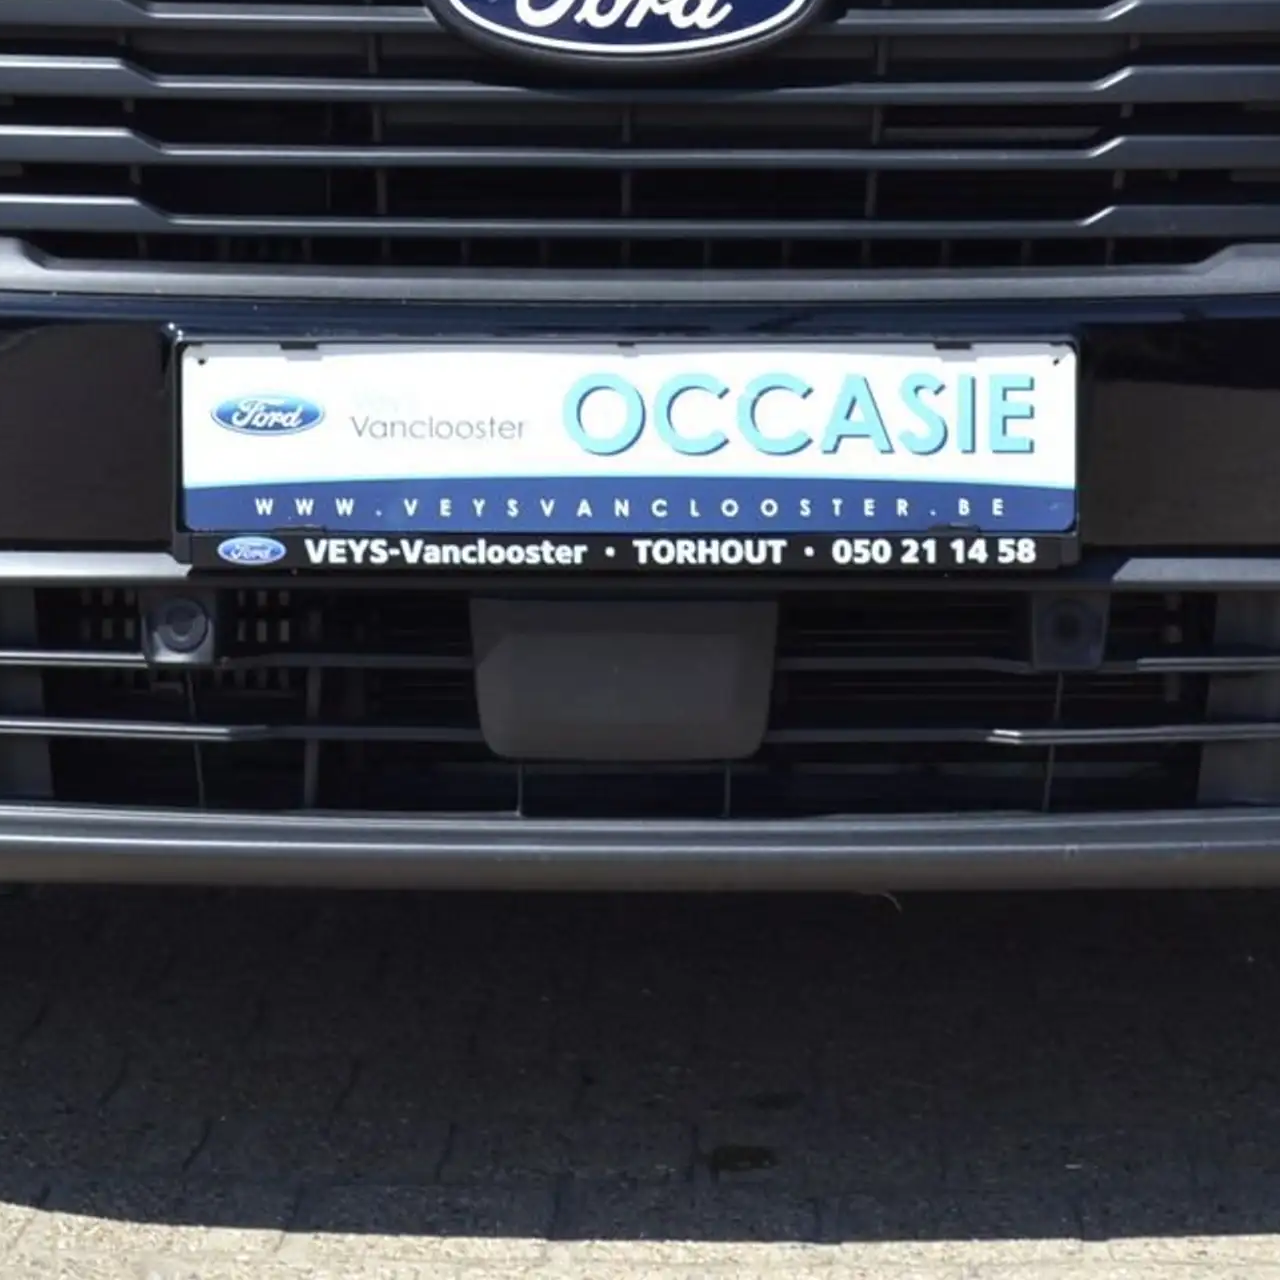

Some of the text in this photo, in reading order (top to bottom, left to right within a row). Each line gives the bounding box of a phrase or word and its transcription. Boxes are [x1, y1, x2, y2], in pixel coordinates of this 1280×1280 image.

[232, 398, 304, 428] Ford
[561, 372, 1035, 456] OCCASIE
[350, 416, 526, 440] Vanclooster
[304, 538, 1037, 565] VEYS-Vanclooster TORHOUT 050 21 14 58
